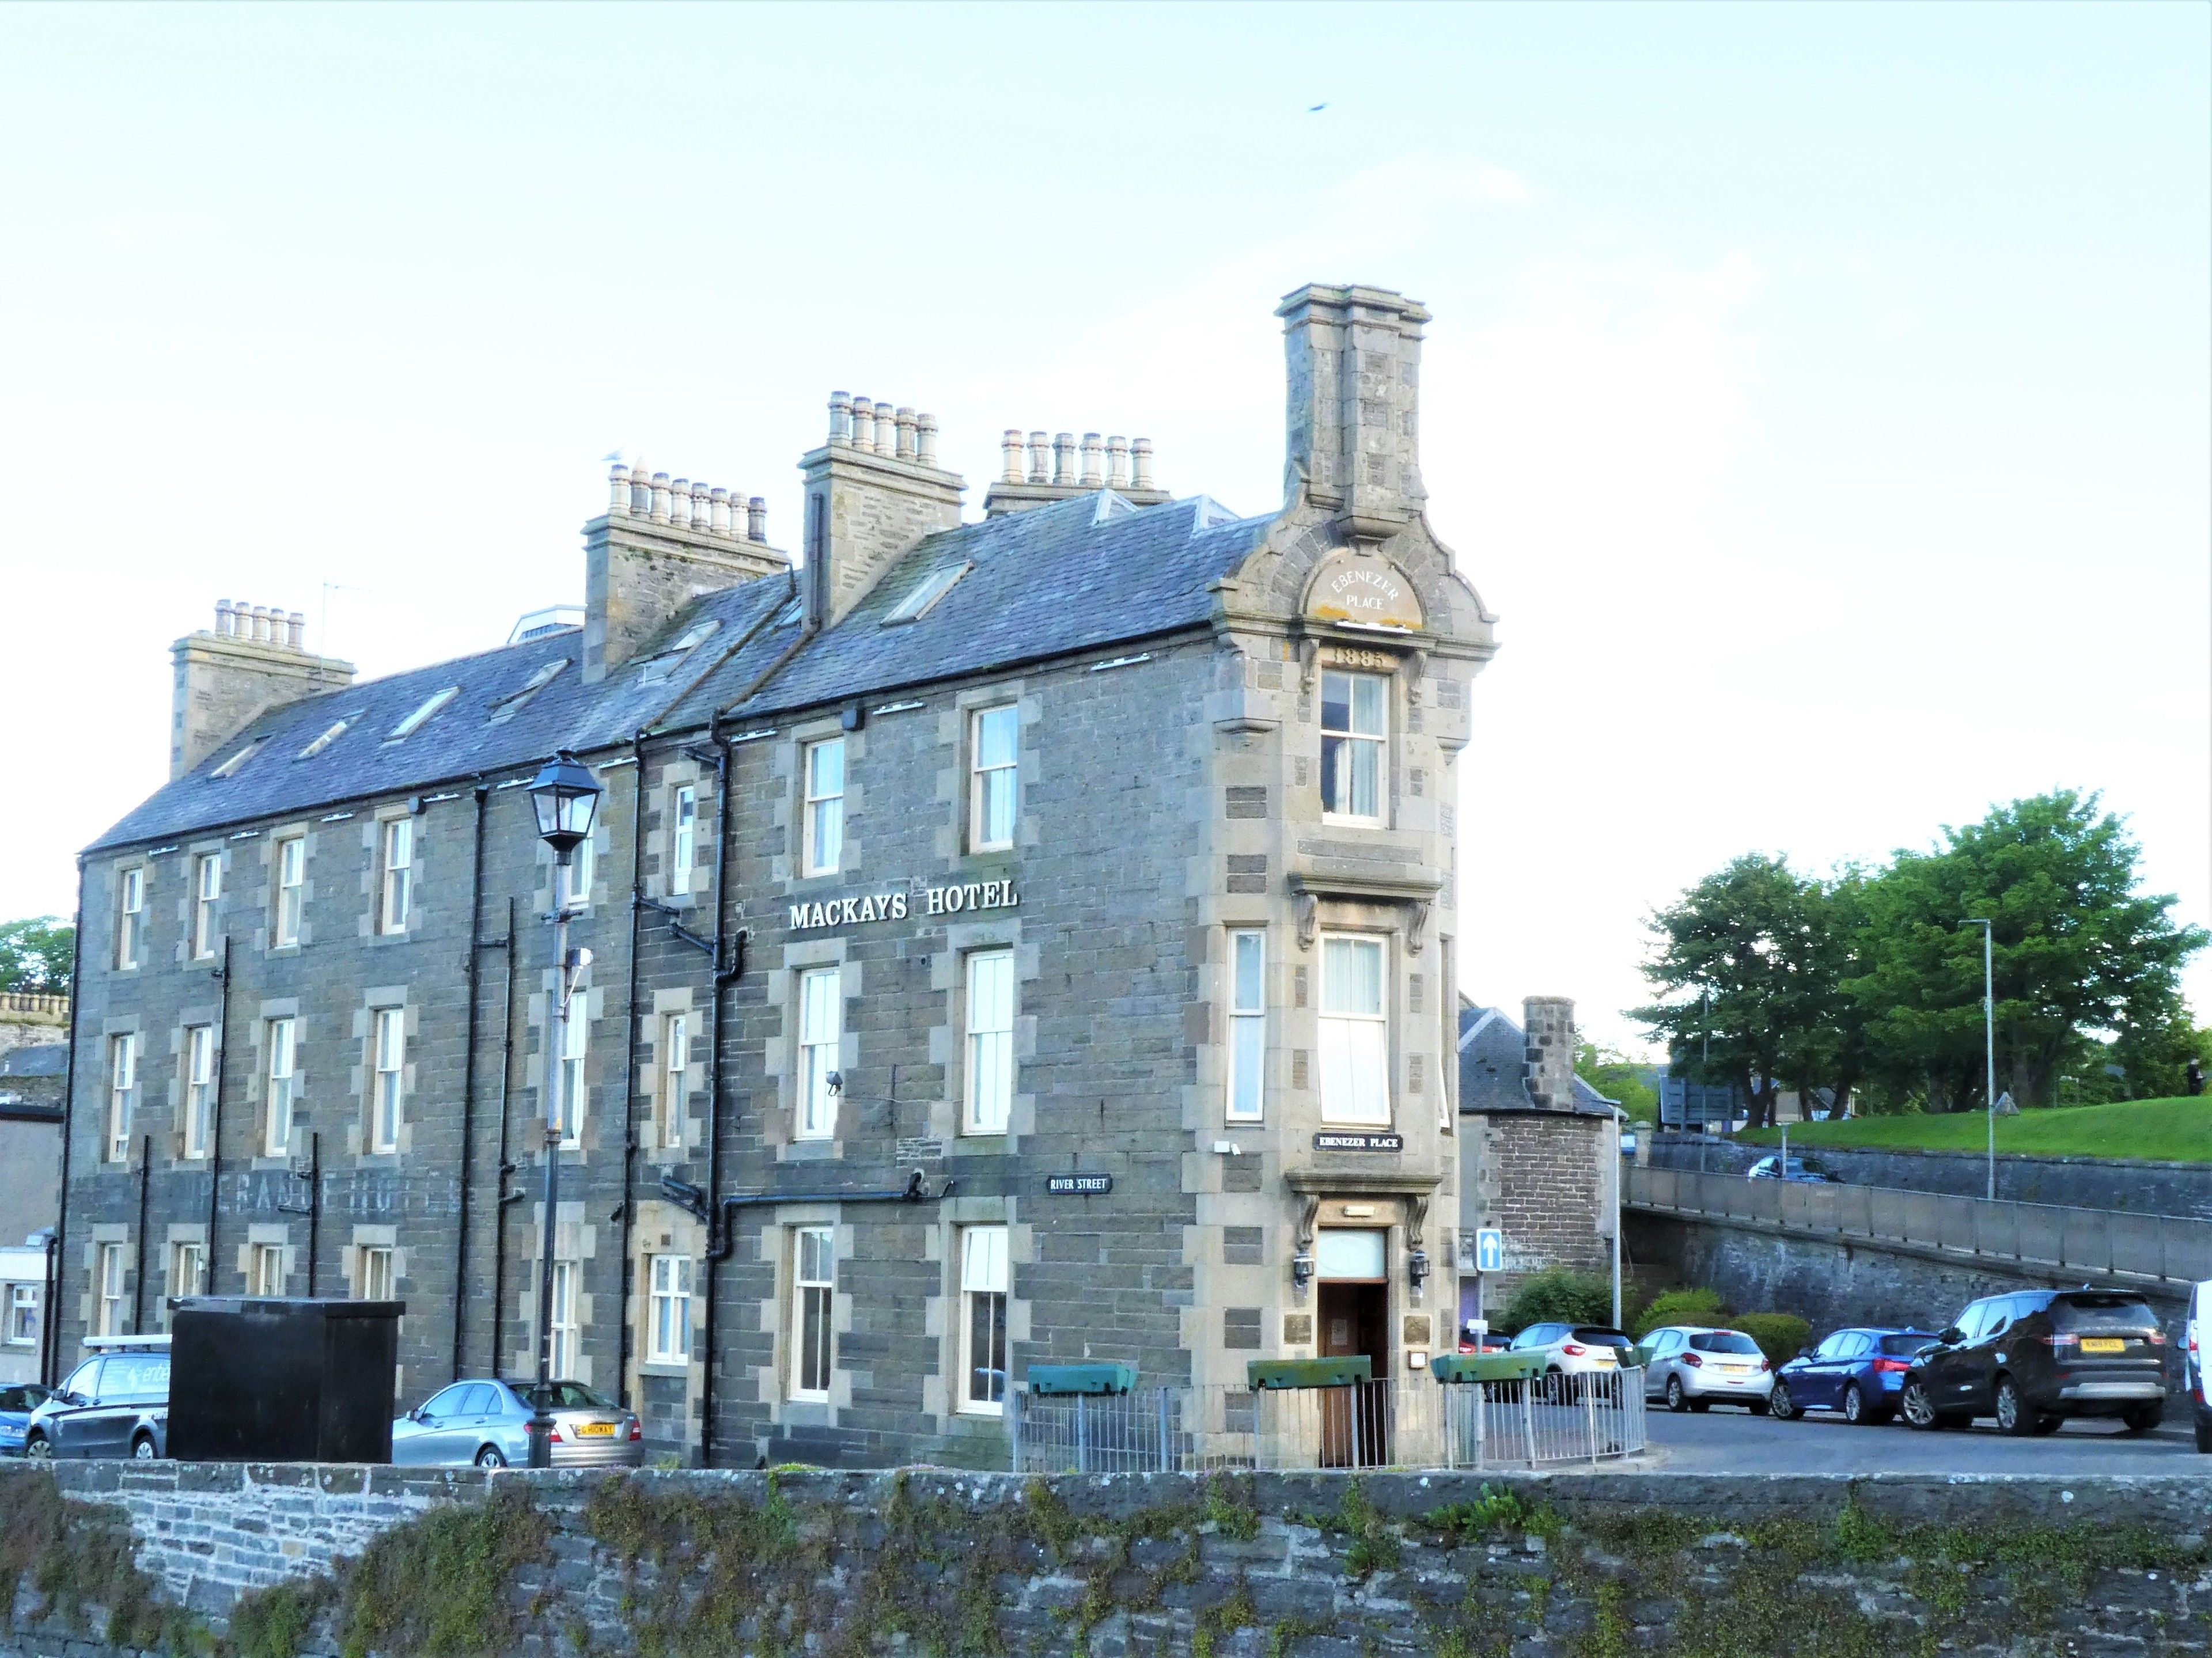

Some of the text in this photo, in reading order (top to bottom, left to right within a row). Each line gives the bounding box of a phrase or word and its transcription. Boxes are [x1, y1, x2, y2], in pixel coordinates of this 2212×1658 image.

[1332, 571, 1399, 600] EBENEZER
[1347, 594, 1384, 609] PLACE
[790, 879, 1017, 931] MACKAYS HOTEL
[1319, 1137, 1398, 1147] EBENEZER PLACE
[1050, 1178, 1107, 1189] RIVER STREET
